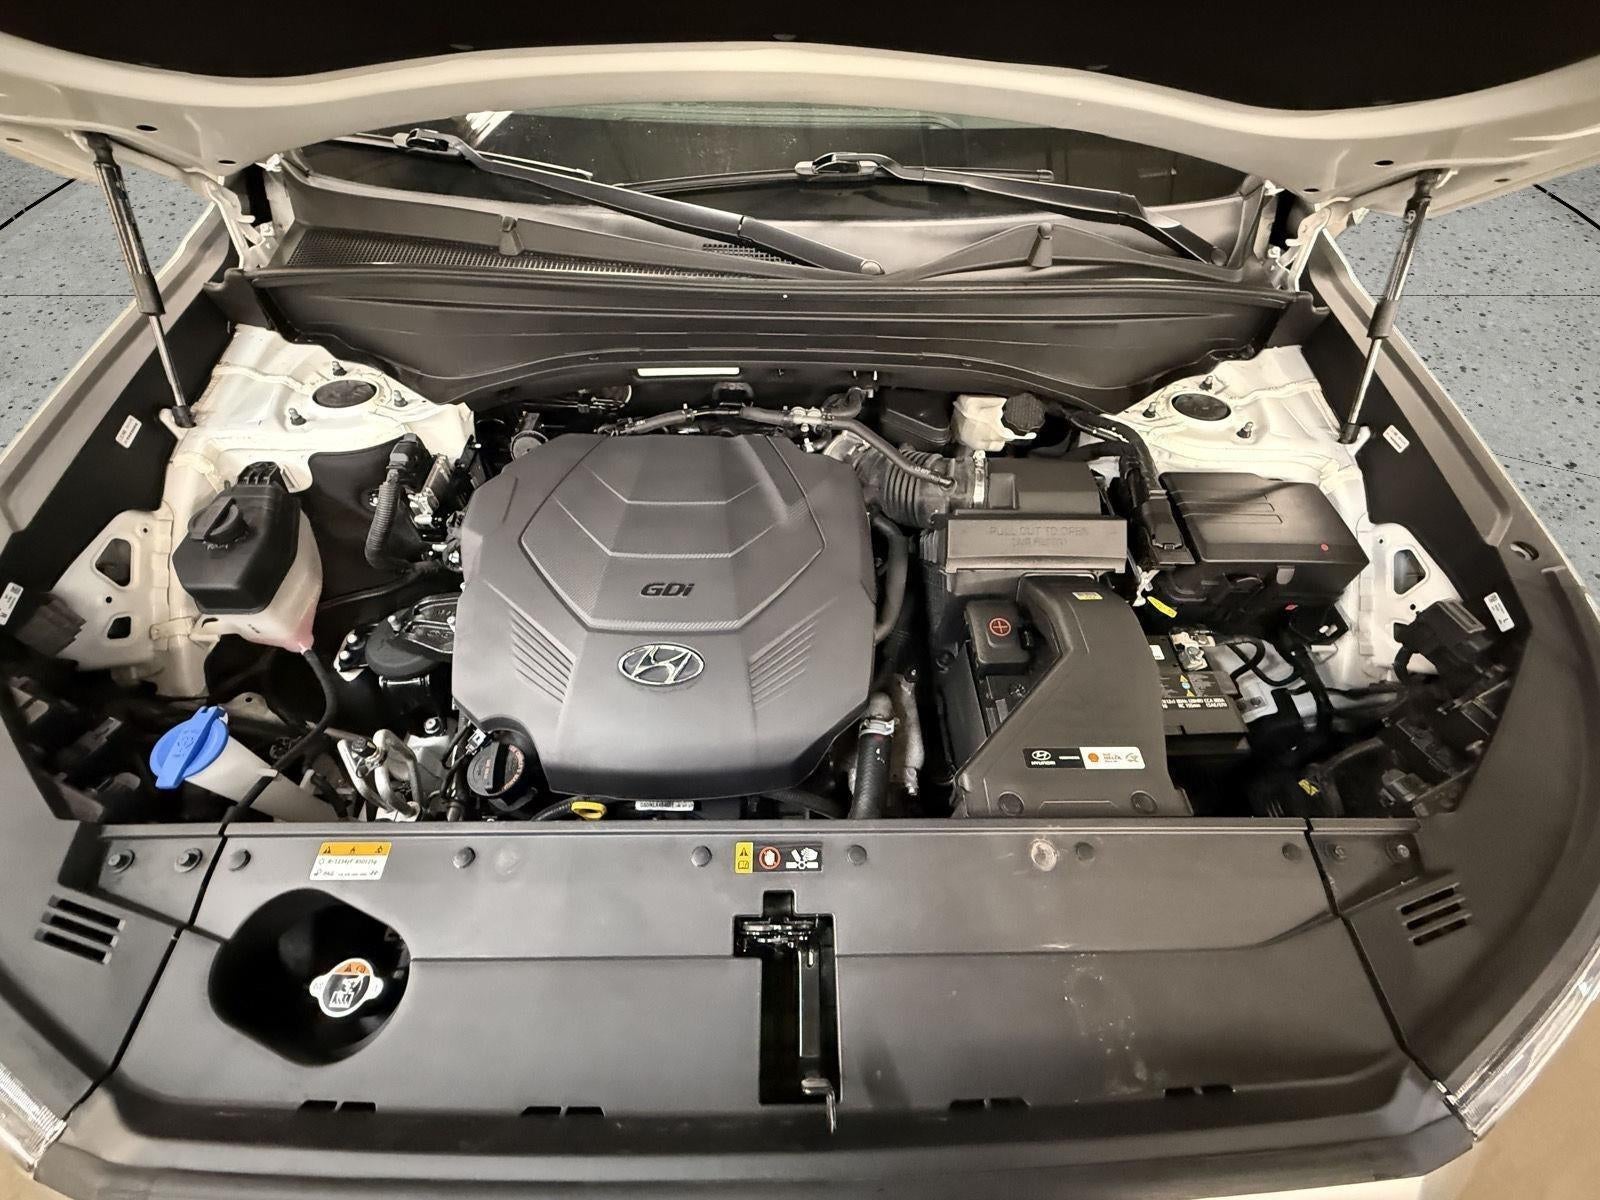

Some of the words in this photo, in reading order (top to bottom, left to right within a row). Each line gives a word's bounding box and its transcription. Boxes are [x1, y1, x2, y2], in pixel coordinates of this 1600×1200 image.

[1019, 526, 1041, 536] OUT
[1045, 526, 1058, 536] TO
[641, 583, 695, 597] GDi
